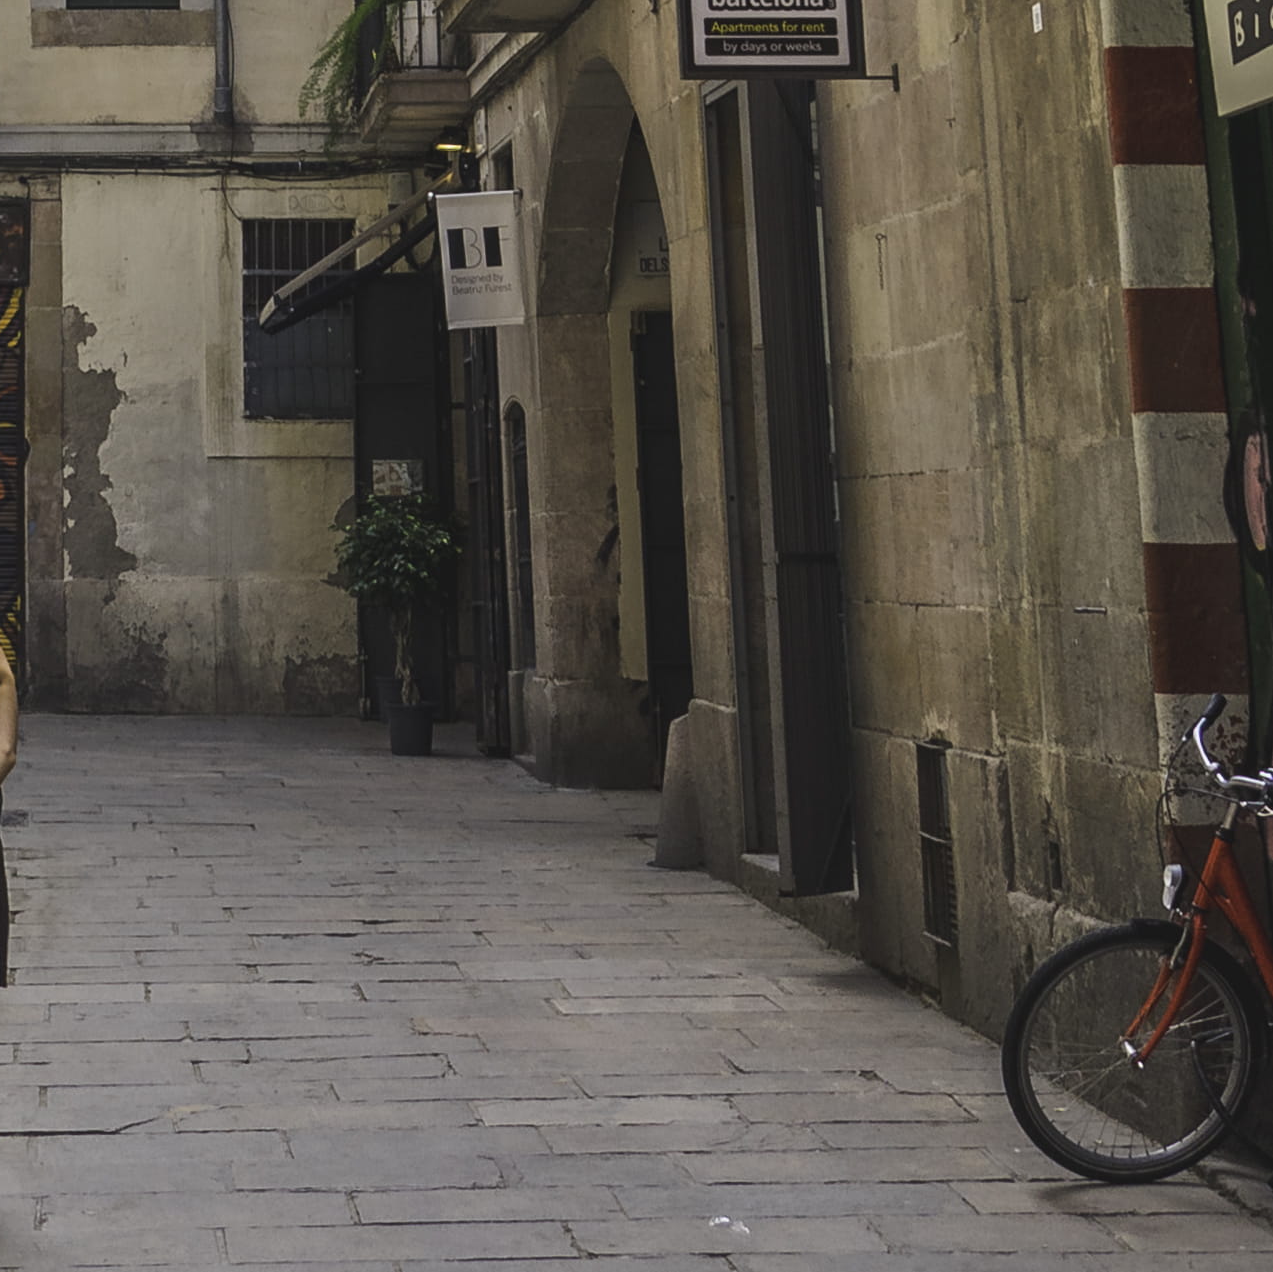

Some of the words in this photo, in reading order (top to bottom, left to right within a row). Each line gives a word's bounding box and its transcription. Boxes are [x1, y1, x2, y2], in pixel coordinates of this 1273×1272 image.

[711, 21, 780, 34] Apartments
[781, 21, 799, 33] for
[801, 22, 825, 33] rent
[722, 40, 738, 55] by
[740, 40, 768, 55] days
[769, 42, 784, 52] or
[784, 40, 822, 53] weeks
[447, 224, 511, 270] BF
[639, 257, 670, 273] DELS
[451, 274, 491, 286] Designed
[493, 272, 504, 284] by
